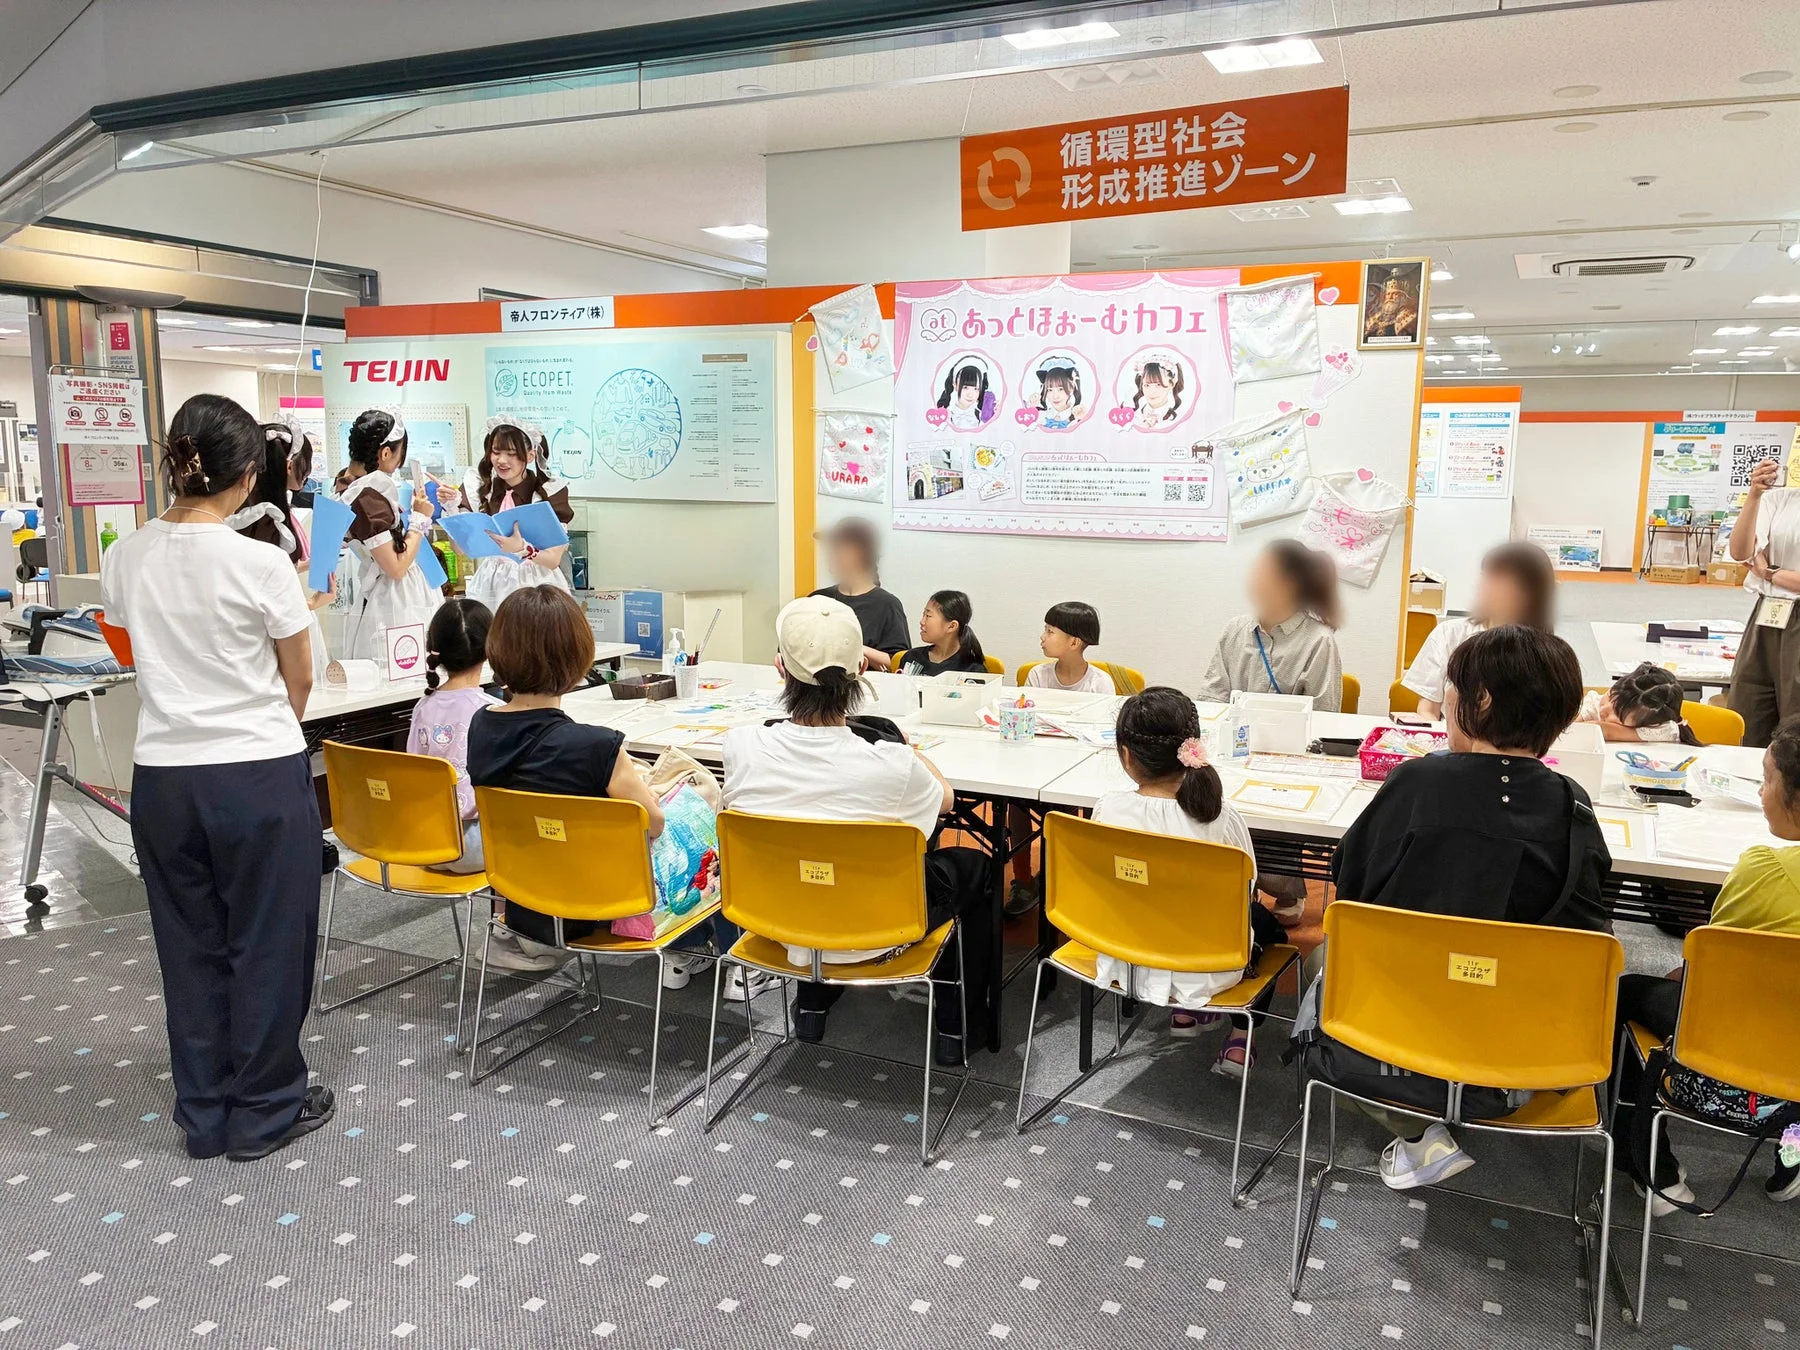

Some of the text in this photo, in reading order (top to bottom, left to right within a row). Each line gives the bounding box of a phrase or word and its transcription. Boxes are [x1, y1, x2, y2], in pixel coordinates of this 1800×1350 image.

[1059, 111, 1248, 169] 循環型社会
[1060, 151, 1317, 211] 形成推進ゾーン
[510, 305, 605, 323] 帝人フロンティア(株)
[929, 313, 947, 330] at
[343, 359, 450, 387] TEIJIN
[831, 471, 869, 486] URARA
[1456, 964, 1491, 974] エコプラザ
[1462, 971, 1484, 980] 多目的
